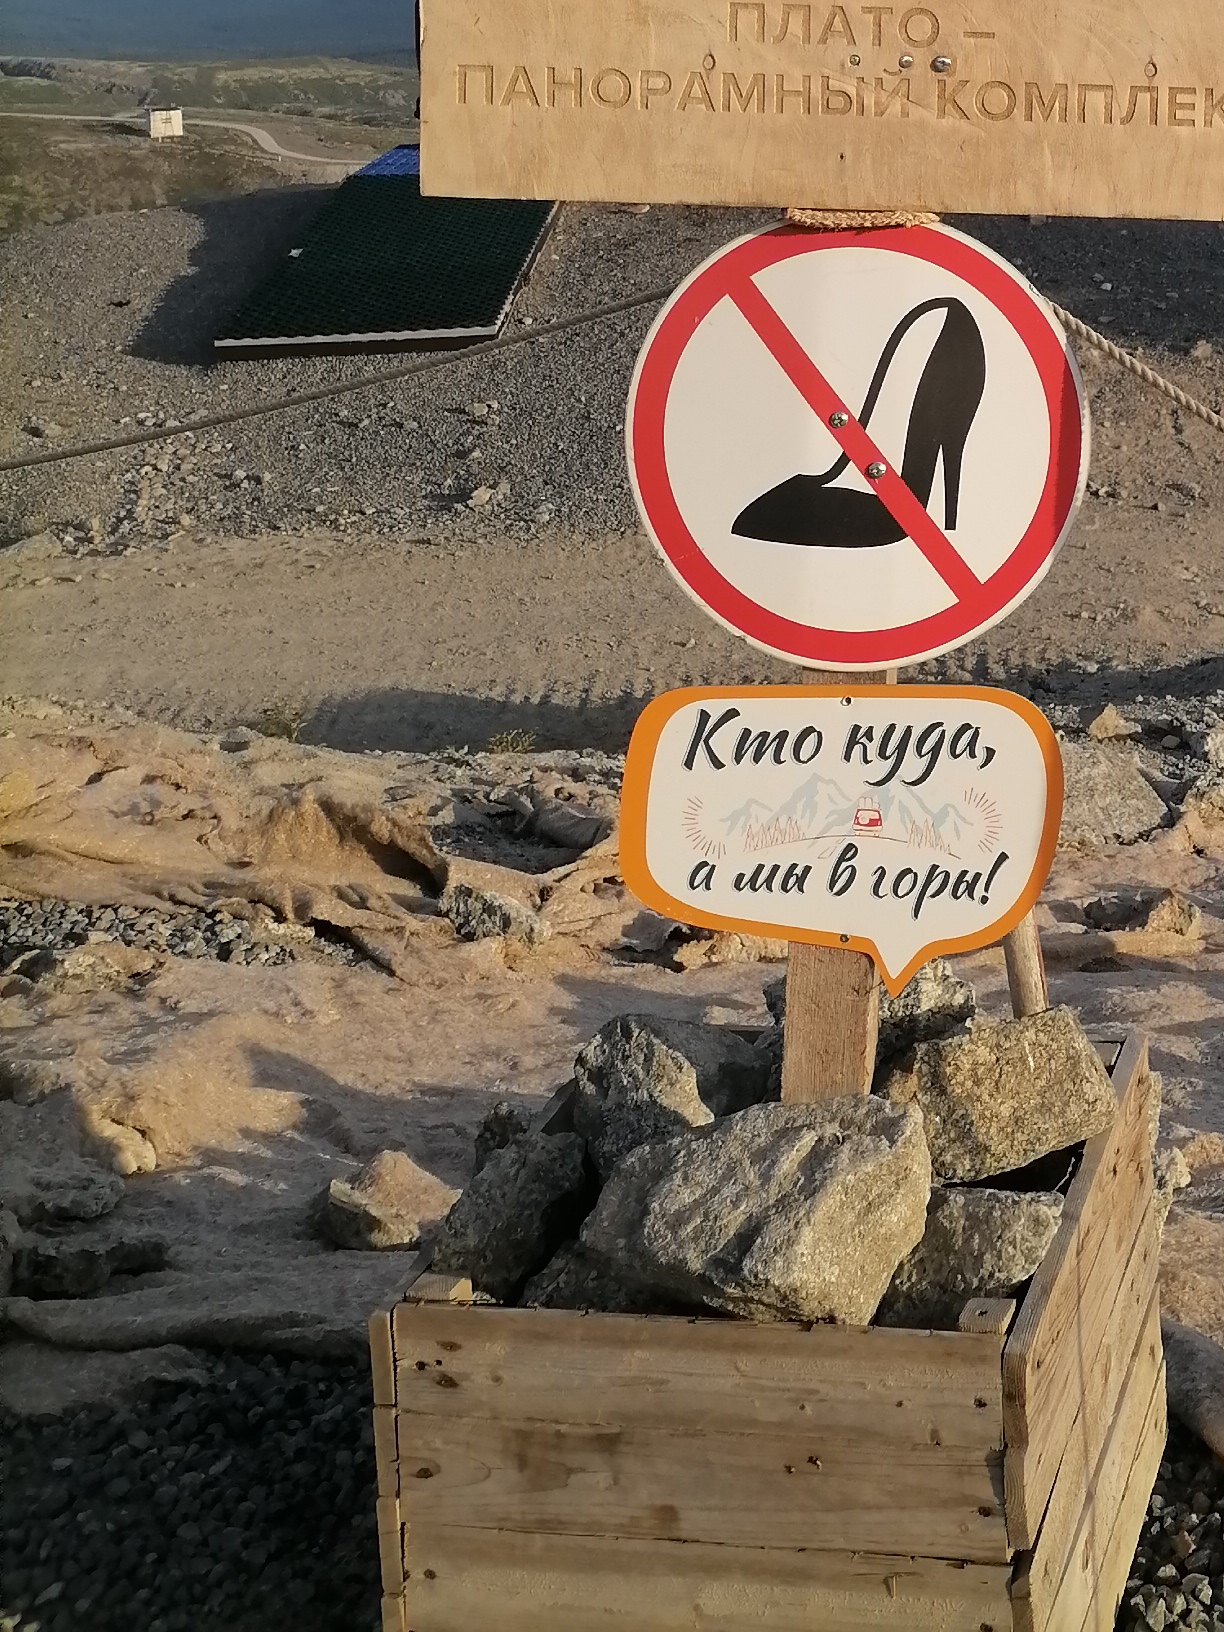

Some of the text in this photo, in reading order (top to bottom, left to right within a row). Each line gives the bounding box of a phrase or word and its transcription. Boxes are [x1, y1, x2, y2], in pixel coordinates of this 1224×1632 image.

[727, 1, 940, 48] ПЛАТО
[455, 62, 911, 118] ПАНОРАМНЫЙ
[683, 707, 997, 788] Кто куда,
[687, 842, 1010, 922] а мы в горы!
